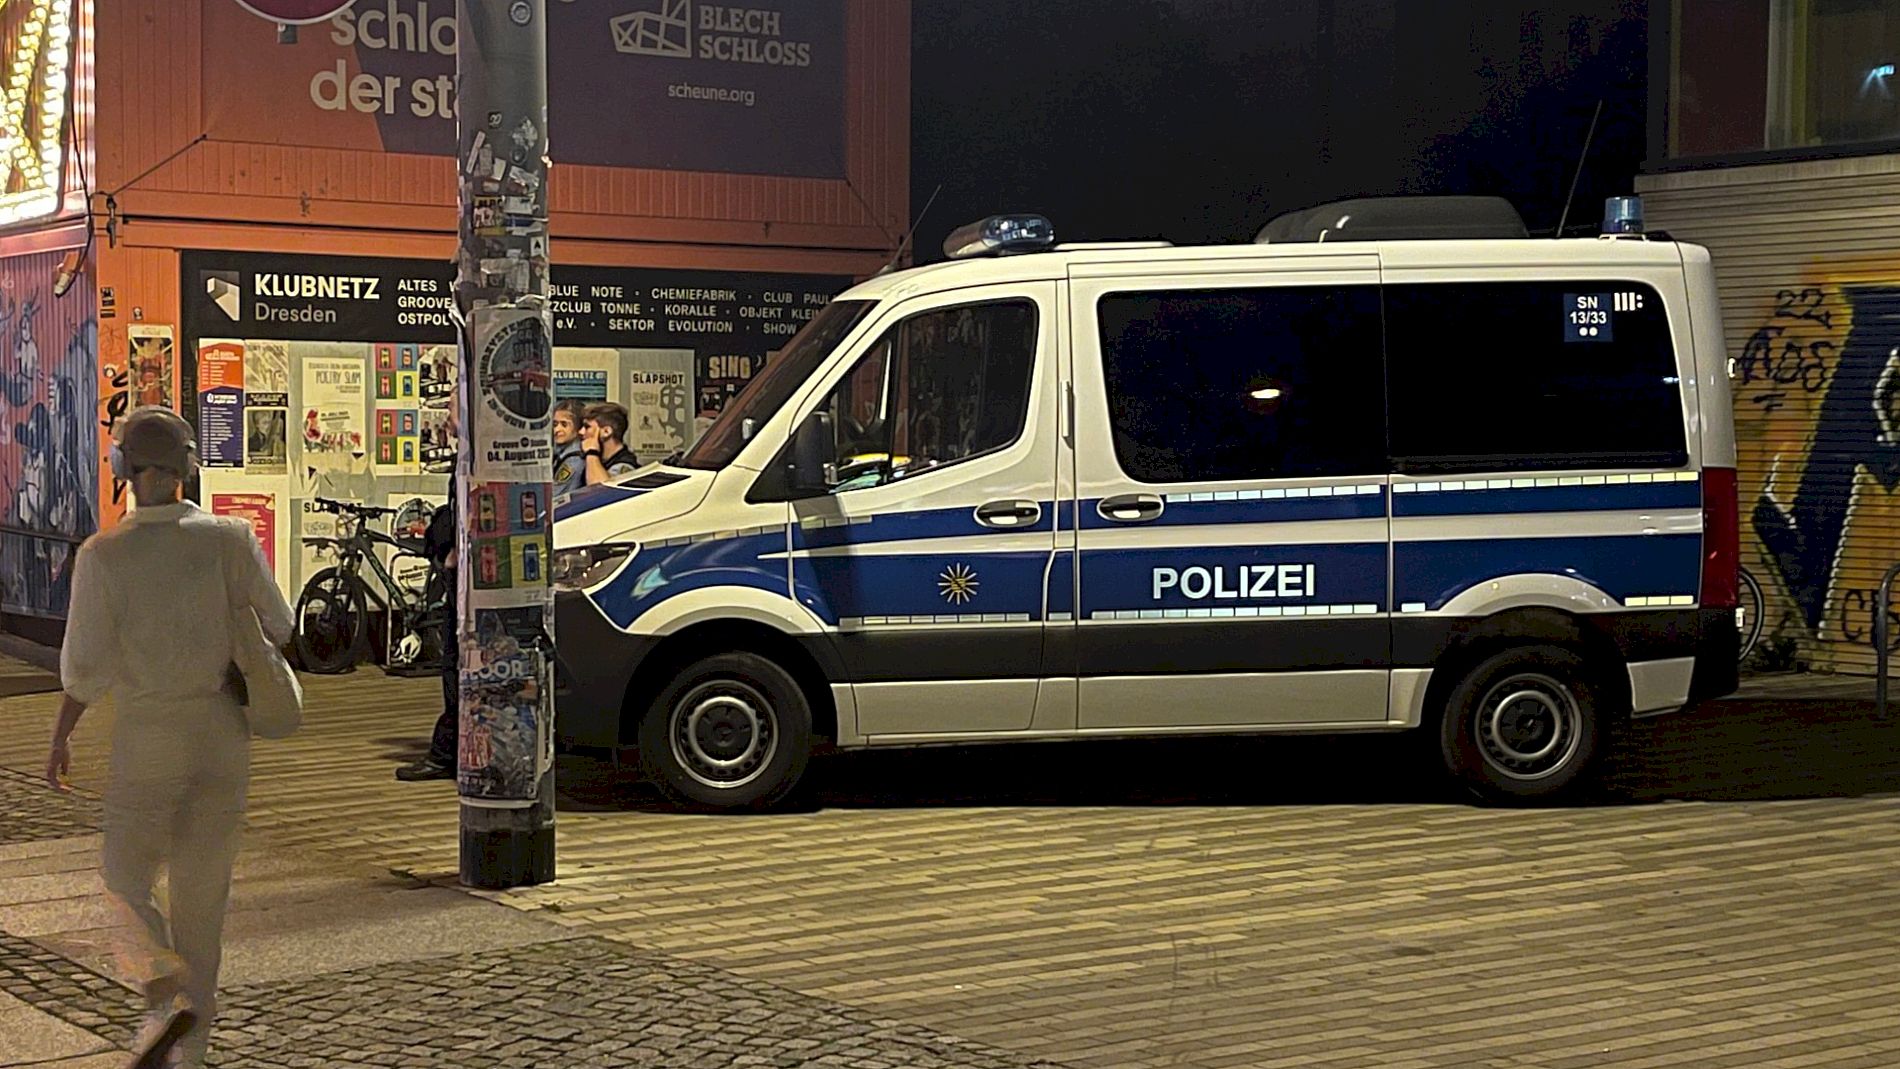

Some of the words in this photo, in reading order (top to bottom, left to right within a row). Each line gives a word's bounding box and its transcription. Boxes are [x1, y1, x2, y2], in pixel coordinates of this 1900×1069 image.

[699, 5, 780, 36] BLECH
[699, 34, 811, 67] SCHLOSS
[310, 59, 400, 114] der
[411, 75, 459, 119] st
[668, 82, 755, 106] scheune.org
[255, 273, 380, 300] KLUBNETZ
[397, 279, 438, 292] ALTES
[397, 296, 452, 309] GROOVE
[591, 286, 623, 298] NOTE
[651, 288, 737, 301] CHEMIEFABRIK
[763, 292, 793, 304] CLUB
[1577, 296, 1598, 309] SN
[255, 302, 337, 323] Dresden
[397, 312, 450, 326] OSTPOL
[600, 302, 641, 314] TONNE
[664, 304, 717, 317] KORALLE
[739, 306, 782, 319] OBJEKT
[1569, 311, 1607, 324] 13/33
[608, 318, 655, 331] SEKTOR
[668, 320, 733, 333] EVOLUTION
[763, 322, 797, 335] SHOW
[633, 373, 684, 384] SLAPSHOT
[1153, 564, 1315, 599] POLIZEI
